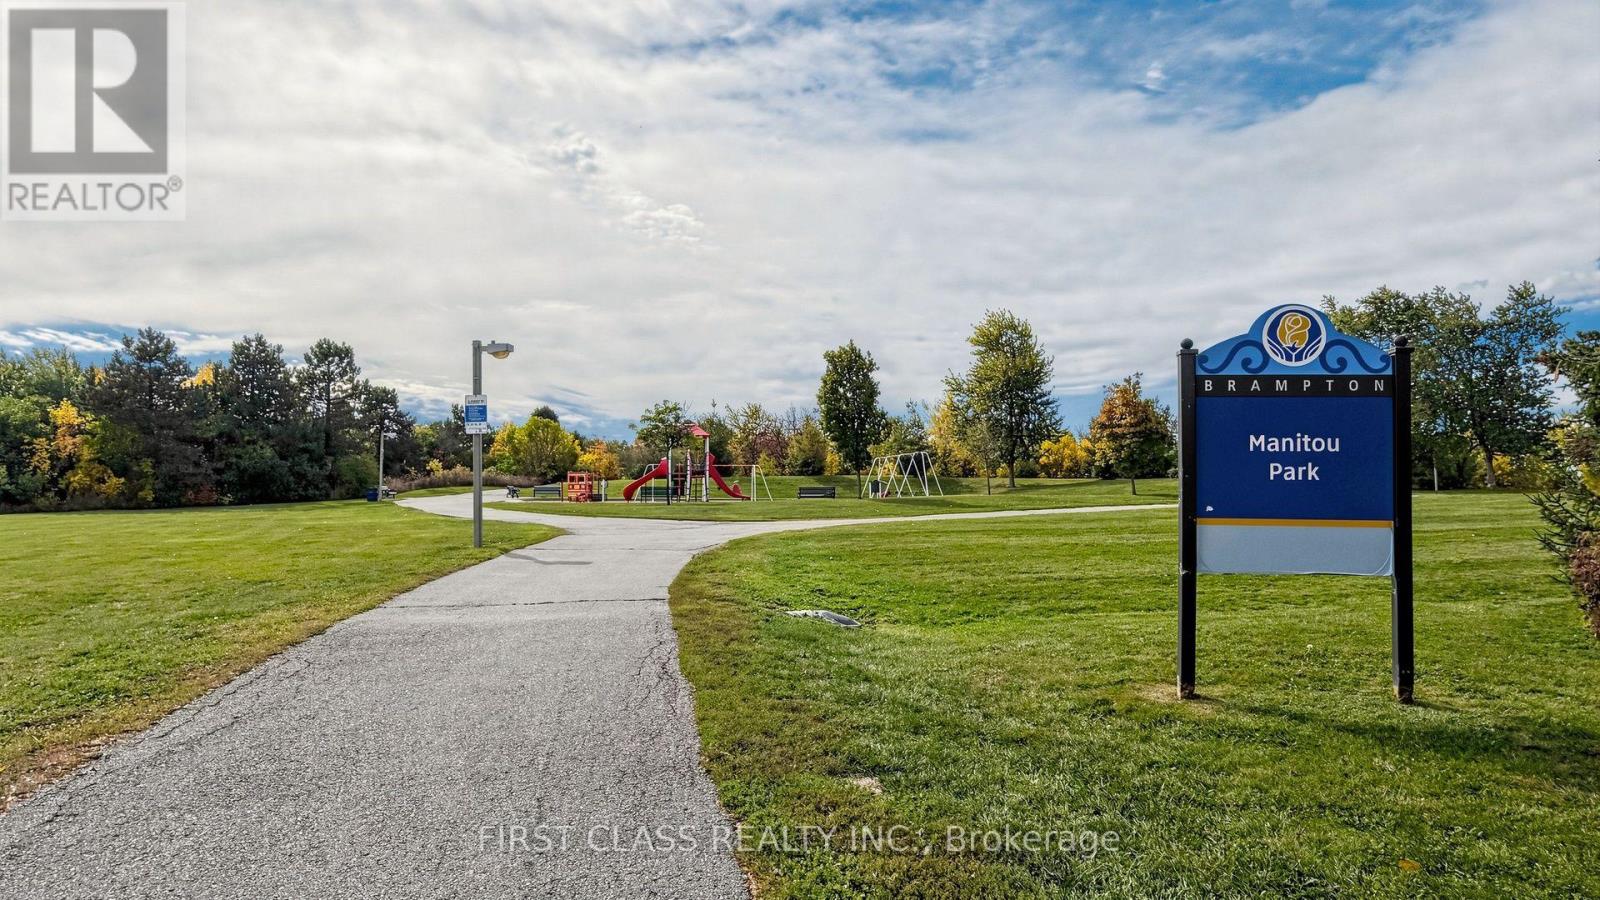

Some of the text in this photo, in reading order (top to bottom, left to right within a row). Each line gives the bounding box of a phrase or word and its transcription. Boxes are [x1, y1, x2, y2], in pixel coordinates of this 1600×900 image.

[1204, 379, 1385, 392] BRAMPTON
[1249, 433, 1340, 453] Manitou
[1269, 462, 1320, 481] Park
